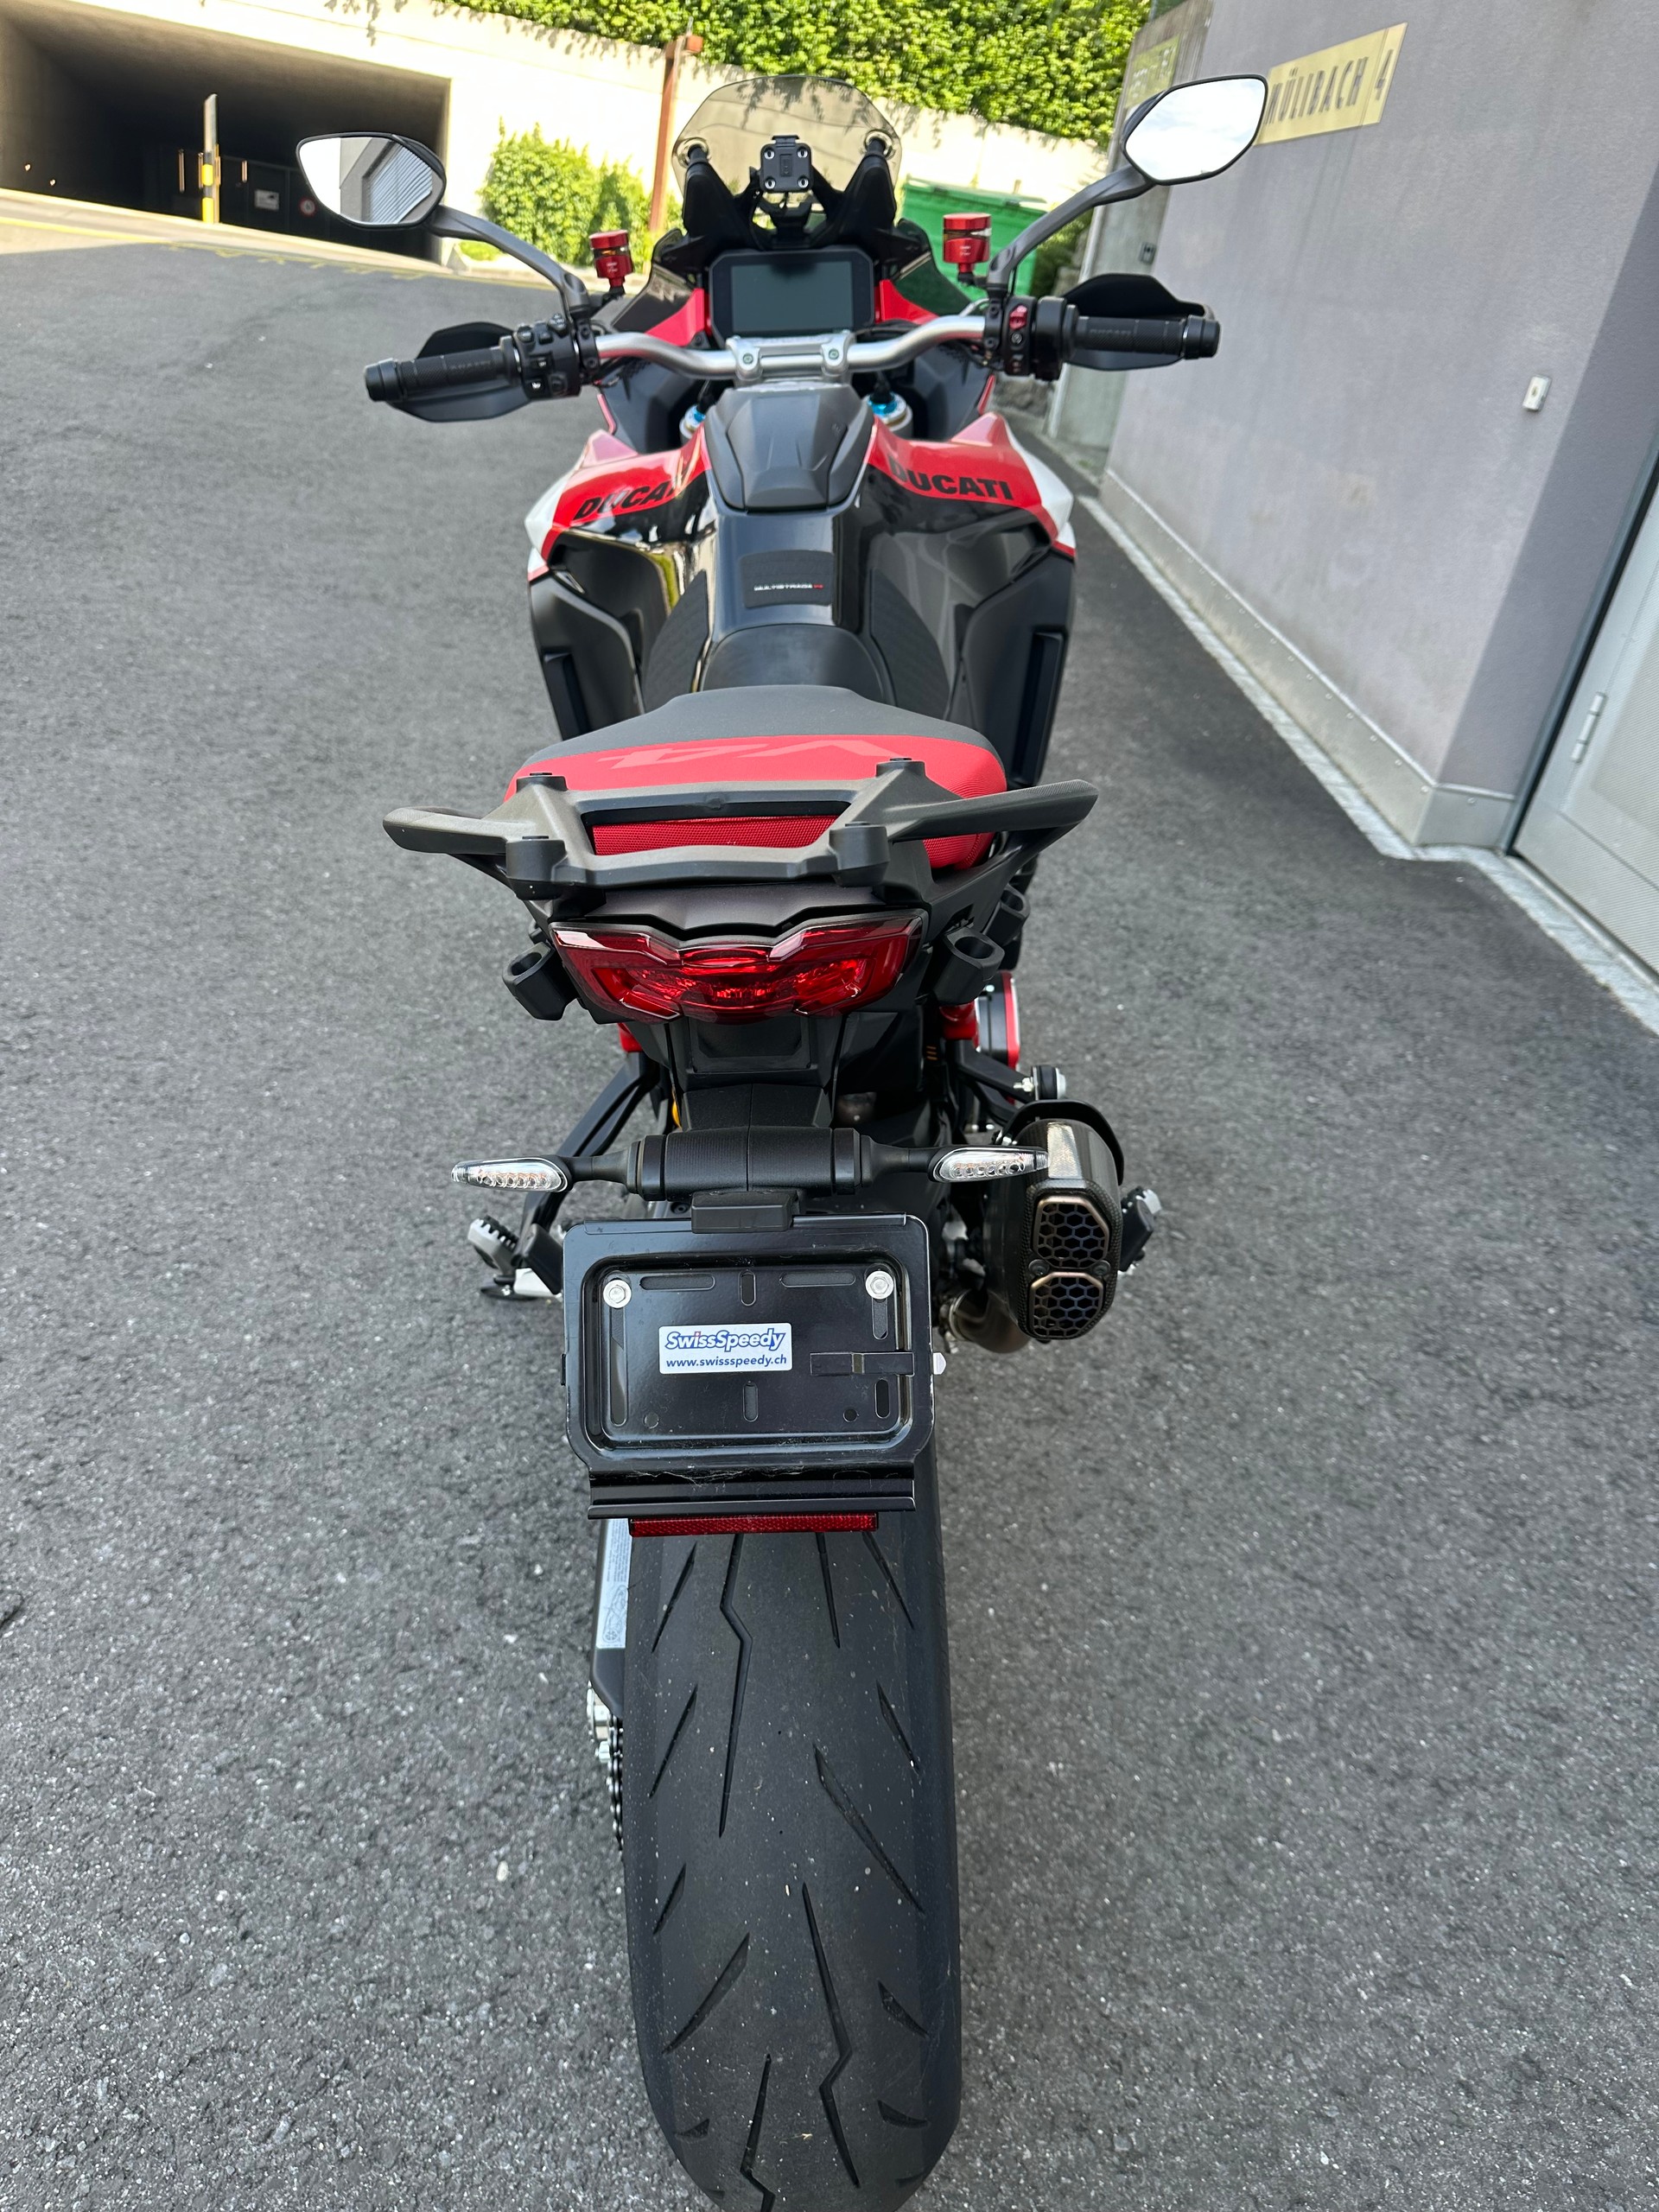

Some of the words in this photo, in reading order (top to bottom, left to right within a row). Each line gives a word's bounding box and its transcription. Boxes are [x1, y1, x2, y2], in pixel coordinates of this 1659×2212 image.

[1376, 48, 1394, 101] 4
[888, 456, 1014, 500] DUCATI
[664, 1328, 785, 1352] SwissSpeedy
[666, 1354, 787, 1368] www.swissspeedy.ch
